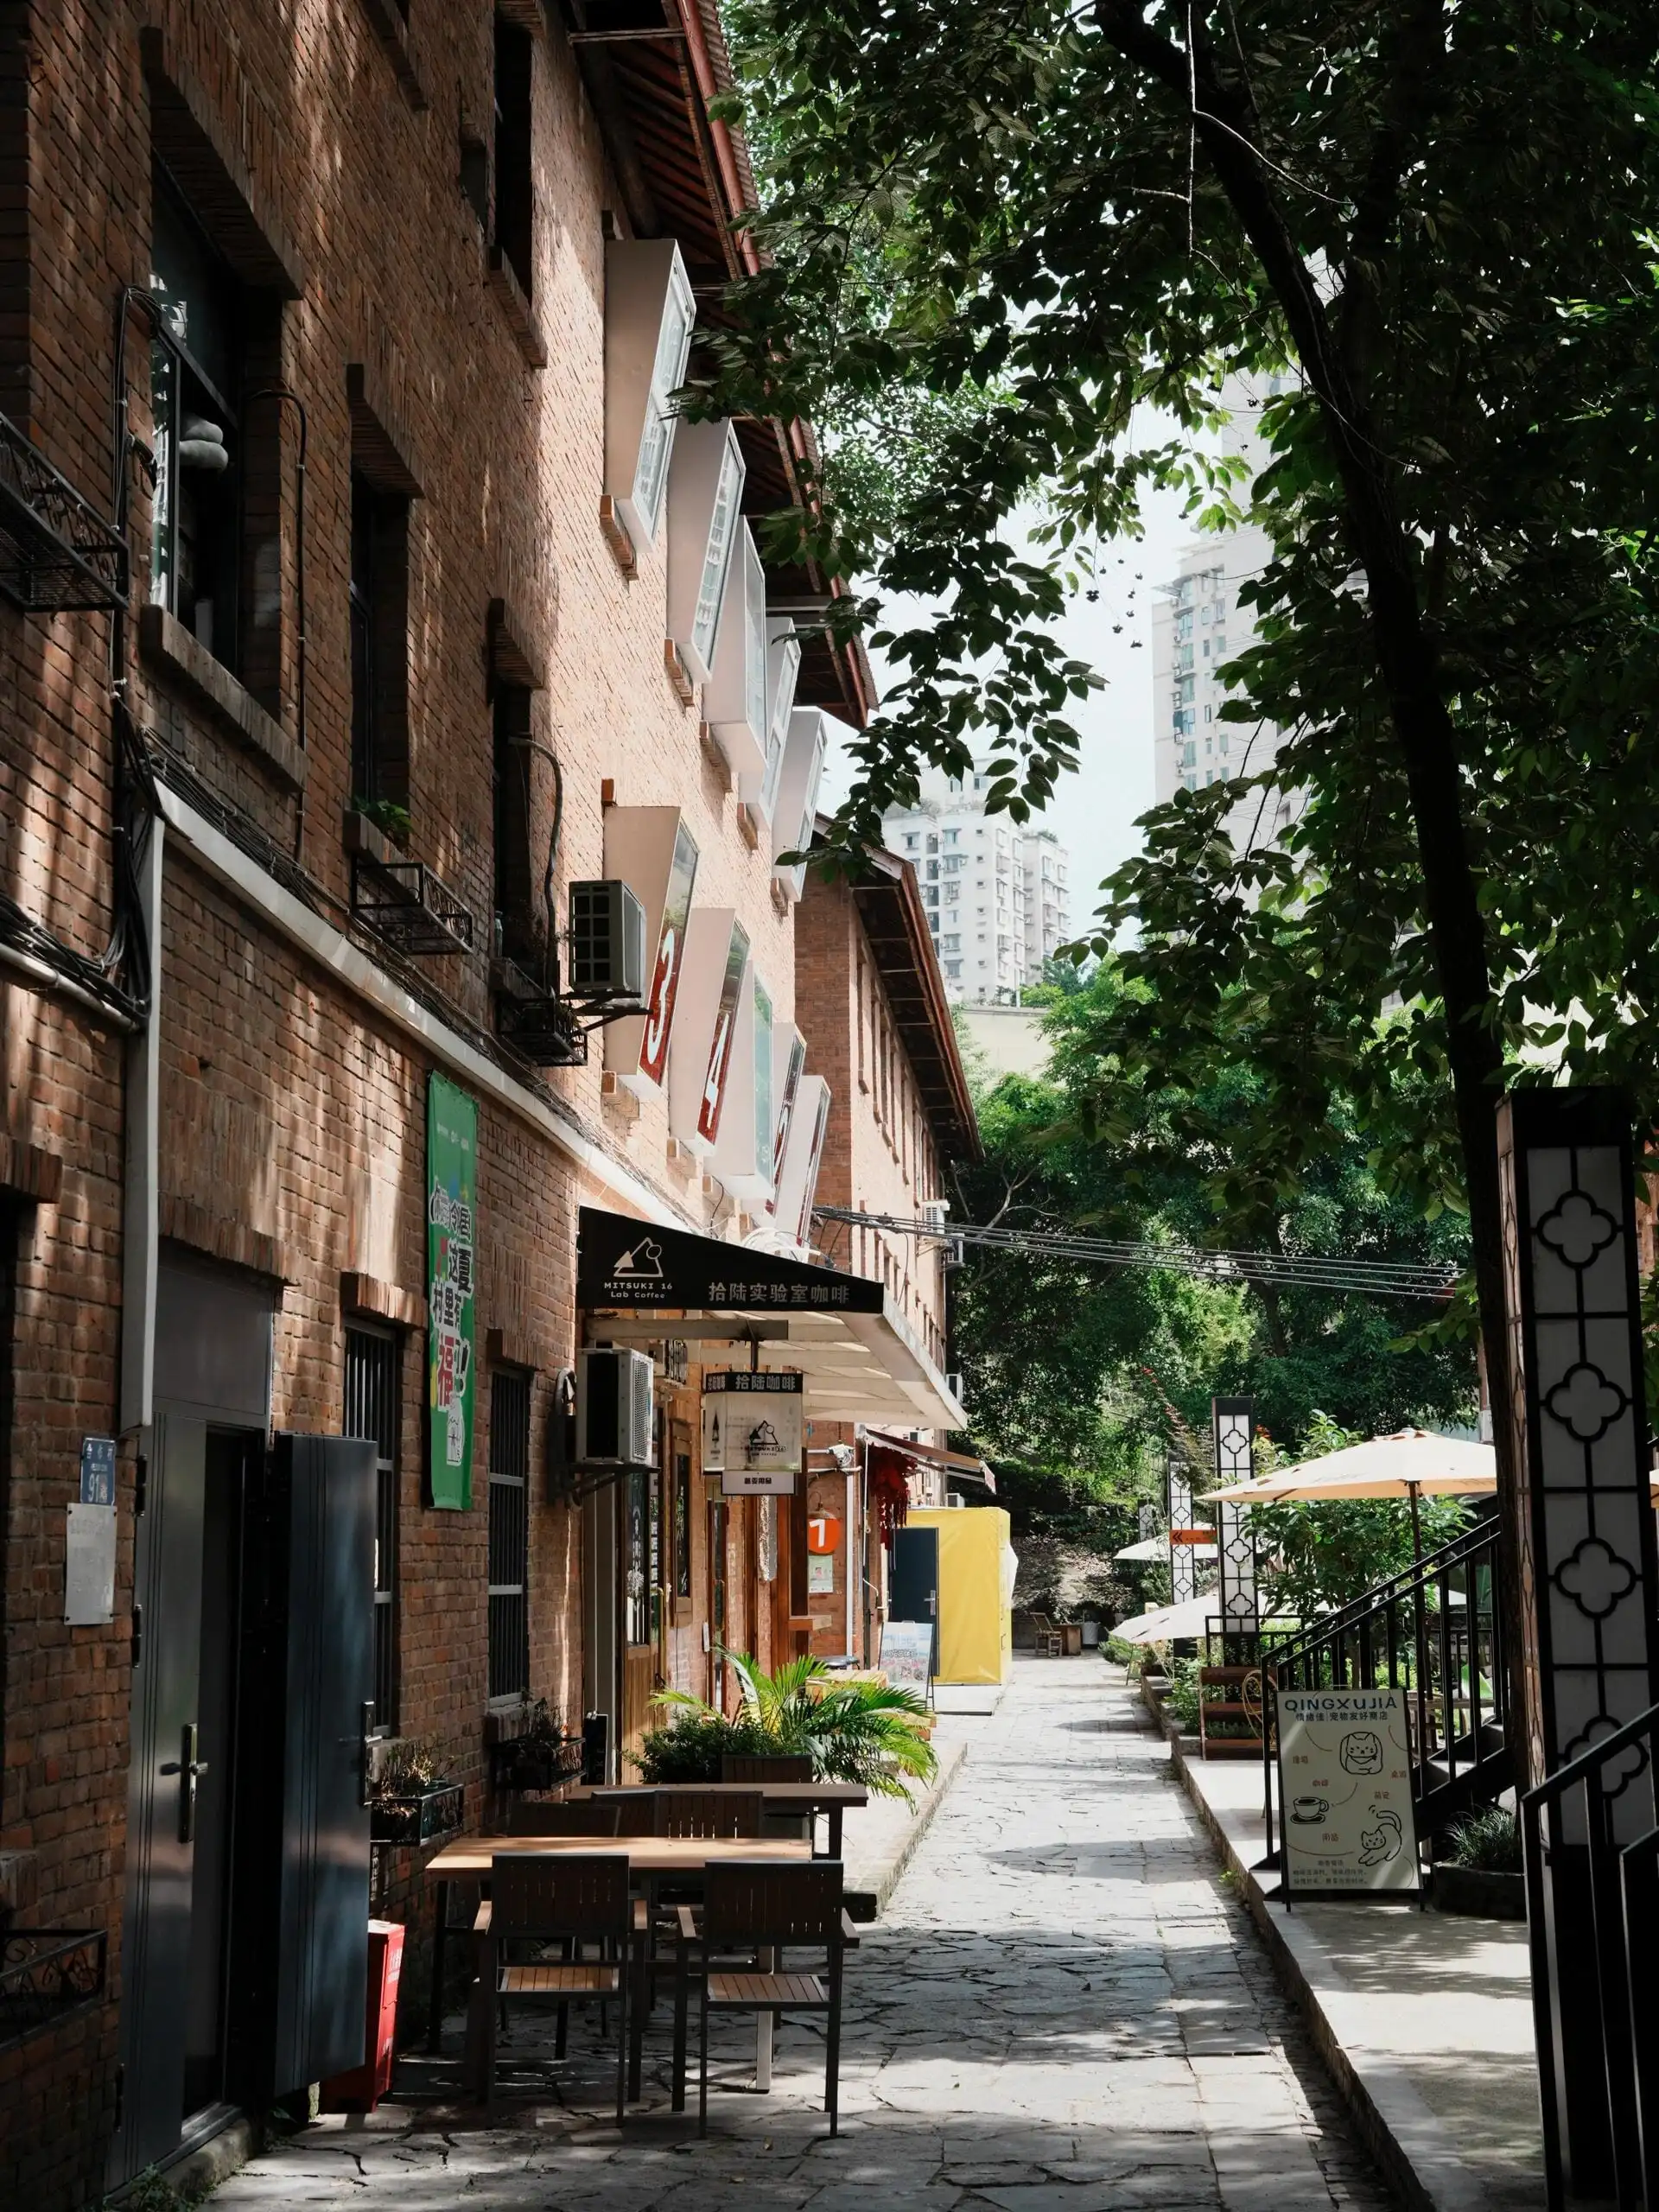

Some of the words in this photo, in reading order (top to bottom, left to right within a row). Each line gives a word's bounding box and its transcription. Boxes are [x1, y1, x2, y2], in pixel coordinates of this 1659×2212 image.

[647, 928, 674, 1065] 3
[707, 1013, 729, 1128] 4
[709, 1281, 849, 1304] 拾陆实验室咖啡
[735, 1375, 796, 1390] 拾陆咖啡
[809, 1519, 825, 1548] 1
[1285, 1696, 1397, 1712] QINGXUJIA
